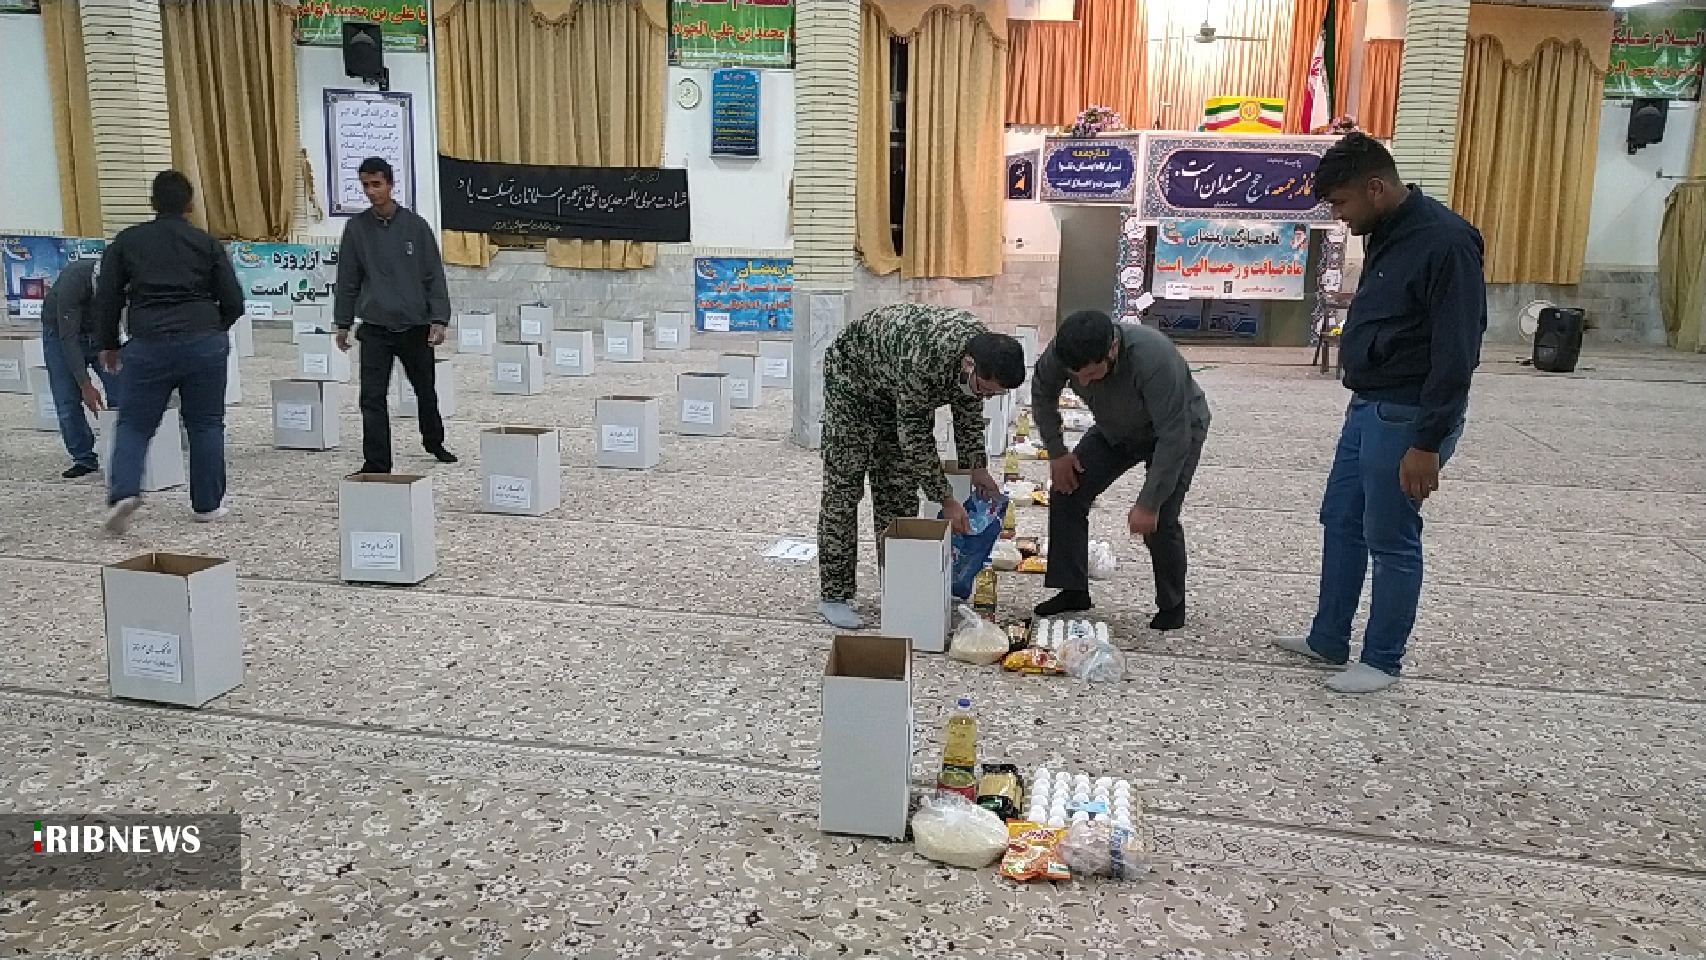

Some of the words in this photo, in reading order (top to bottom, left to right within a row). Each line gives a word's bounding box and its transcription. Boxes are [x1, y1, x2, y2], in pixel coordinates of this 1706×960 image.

[389, 4, 416, 24] علی
[709, 20, 735, 42] علی
[736, 26, 752, 43] بن
[1187, 228, 1230, 248] رمضان
[1230, 227, 1263, 247] مبارک
[1263, 231, 1280, 245] ماه
[1156, 256, 1182, 272] است
[1250, 258, 1286, 278] ضیافت
[1286, 259, 1304, 275] ماه
